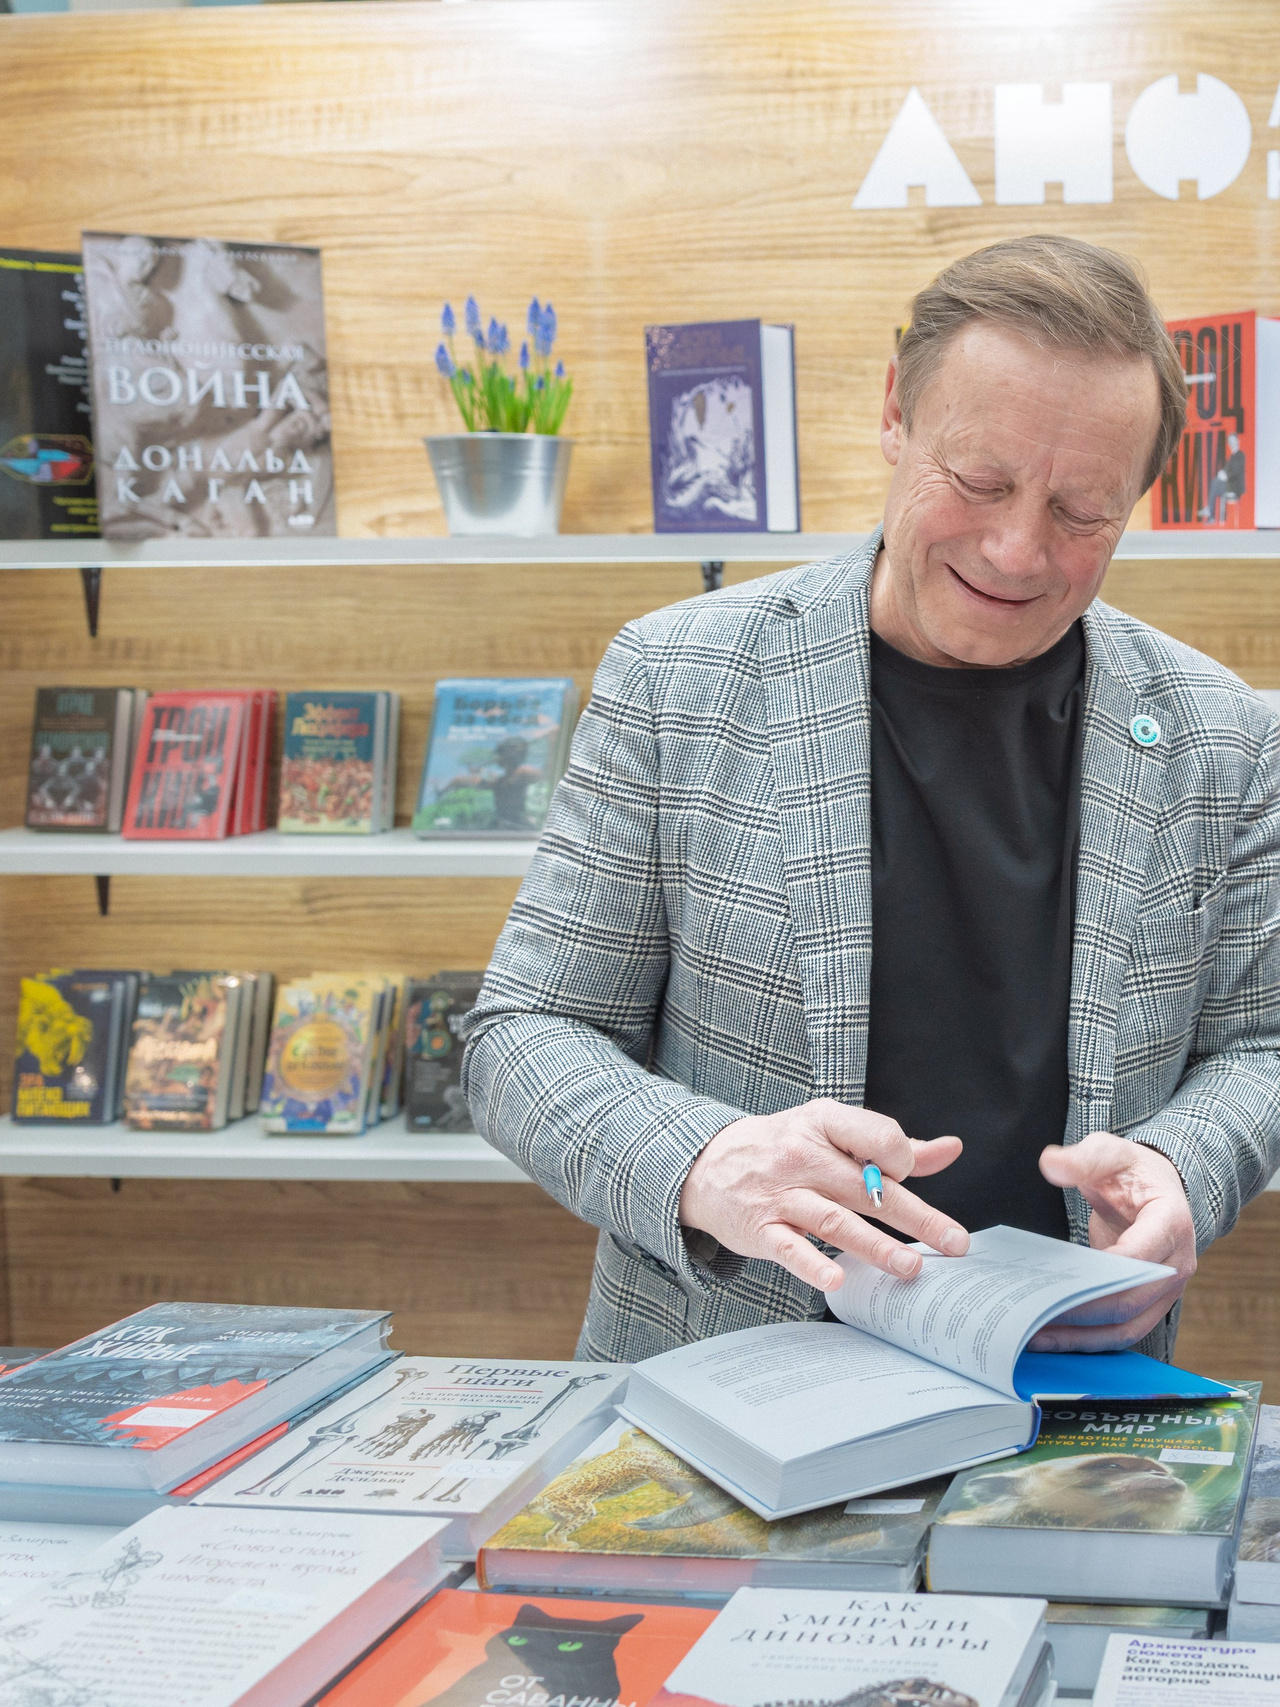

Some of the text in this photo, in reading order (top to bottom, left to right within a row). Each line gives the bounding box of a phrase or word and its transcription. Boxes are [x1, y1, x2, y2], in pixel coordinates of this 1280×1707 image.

[106, 360, 311, 410] ВОЙНА
[112, 445, 314, 474] ДОНАЛЬД
[116, 478, 315, 504] КАГАН
[103, 1325, 184, 1342] КАК
[72, 1340, 212, 1361] ЖИВЫЕ
[445, 1364, 570, 1379] Первые
[453, 1376, 536, 1388] шаги
[1041, 1410, 1235, 1426] ЕОБЪЯТНЫЙ
[1083, 1423, 1156, 1435] МИР
[1132, 1443, 1215, 1451] РЕАЛЬНОСТЬ
[325, 1474, 406, 1485] Десильва
[335, 1467, 416, 1478] Джереми
[847, 1599, 923, 1613] КАК
[778, 1613, 970, 1632] УМИРАЛИ
[731, 1629, 990, 1651] ДИНОЗАВРЫ
[1129, 1639, 1257, 1655] Архитектура
[1127, 1649, 1203, 1660] сюжета
[1125, 1655, 1250, 1670] Как создать
[500, 1674, 545, 1690] ОТ
[1122, 1674, 1211, 1686] историю
